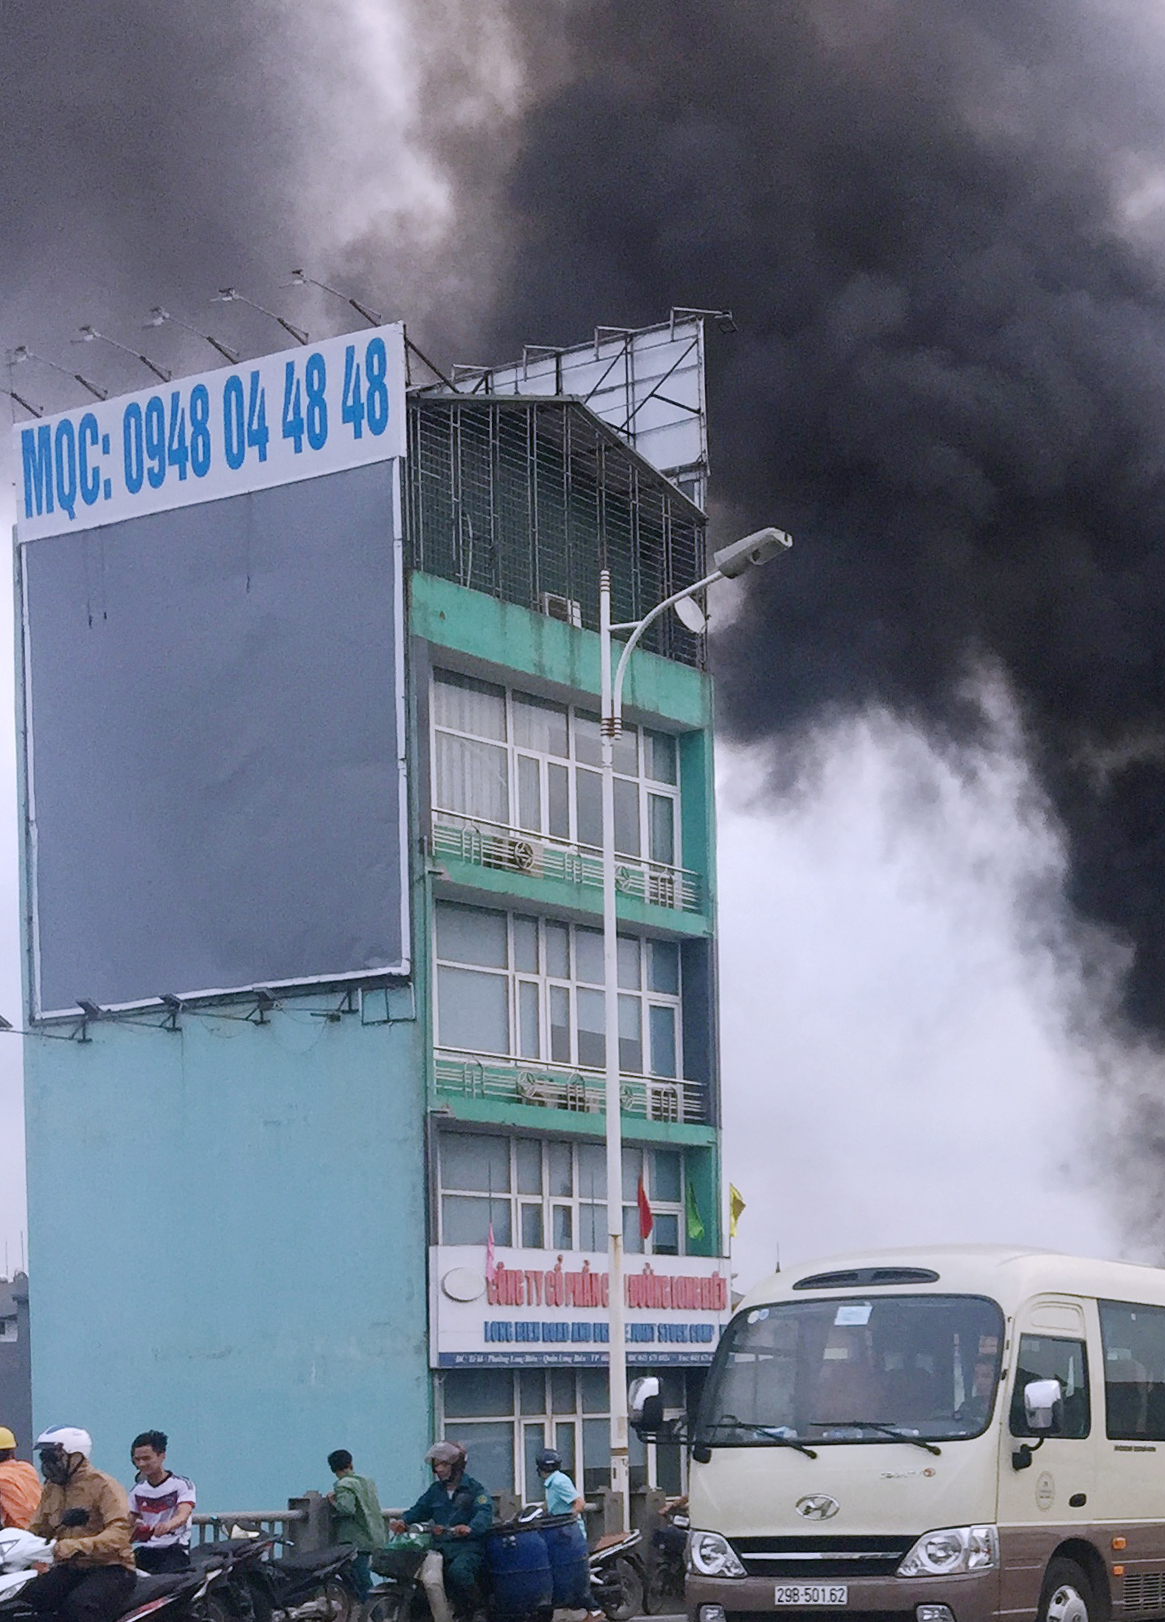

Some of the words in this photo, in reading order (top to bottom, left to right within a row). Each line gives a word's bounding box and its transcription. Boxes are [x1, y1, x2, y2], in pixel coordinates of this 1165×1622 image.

[21, 412, 112, 521] MQC:
[123, 383, 211, 494] 0948
[223, 370, 269, 470] 04
[282, 353, 328, 454] 48
[341, 337, 389, 440] 48
[525, 1269, 544, 1306] TY
[777, 1587, 846, 1603] 29B-501.62
